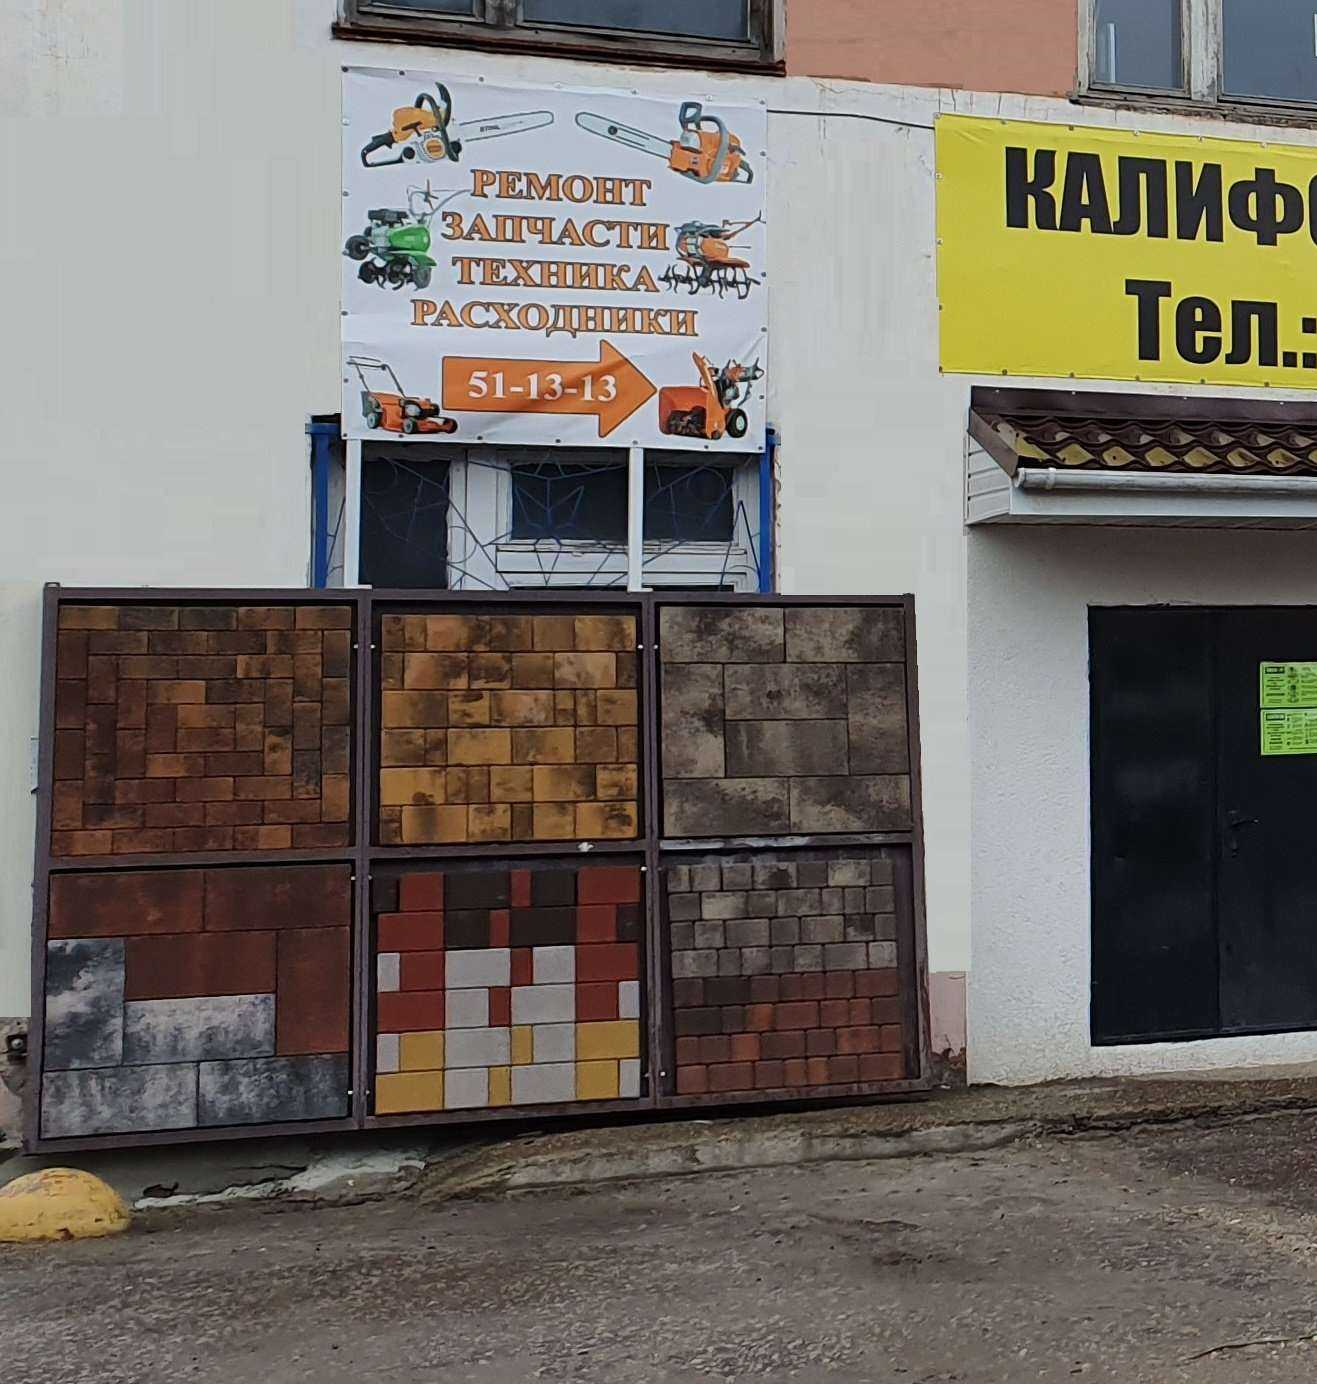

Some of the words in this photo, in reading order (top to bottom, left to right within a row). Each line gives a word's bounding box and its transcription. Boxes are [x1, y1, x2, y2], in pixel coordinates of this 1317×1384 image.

[471, 168, 652, 207] РЕМОНТ
[441, 211, 670, 251] ЗАПЧАСТИ
[452, 257, 660, 292] ТЕХНИКА
[410, 299, 699, 338] РАСХОДНИКИ
[1125, 278, 1317, 370] Тел.:
[467, 370, 617, 402] 51-13-13
